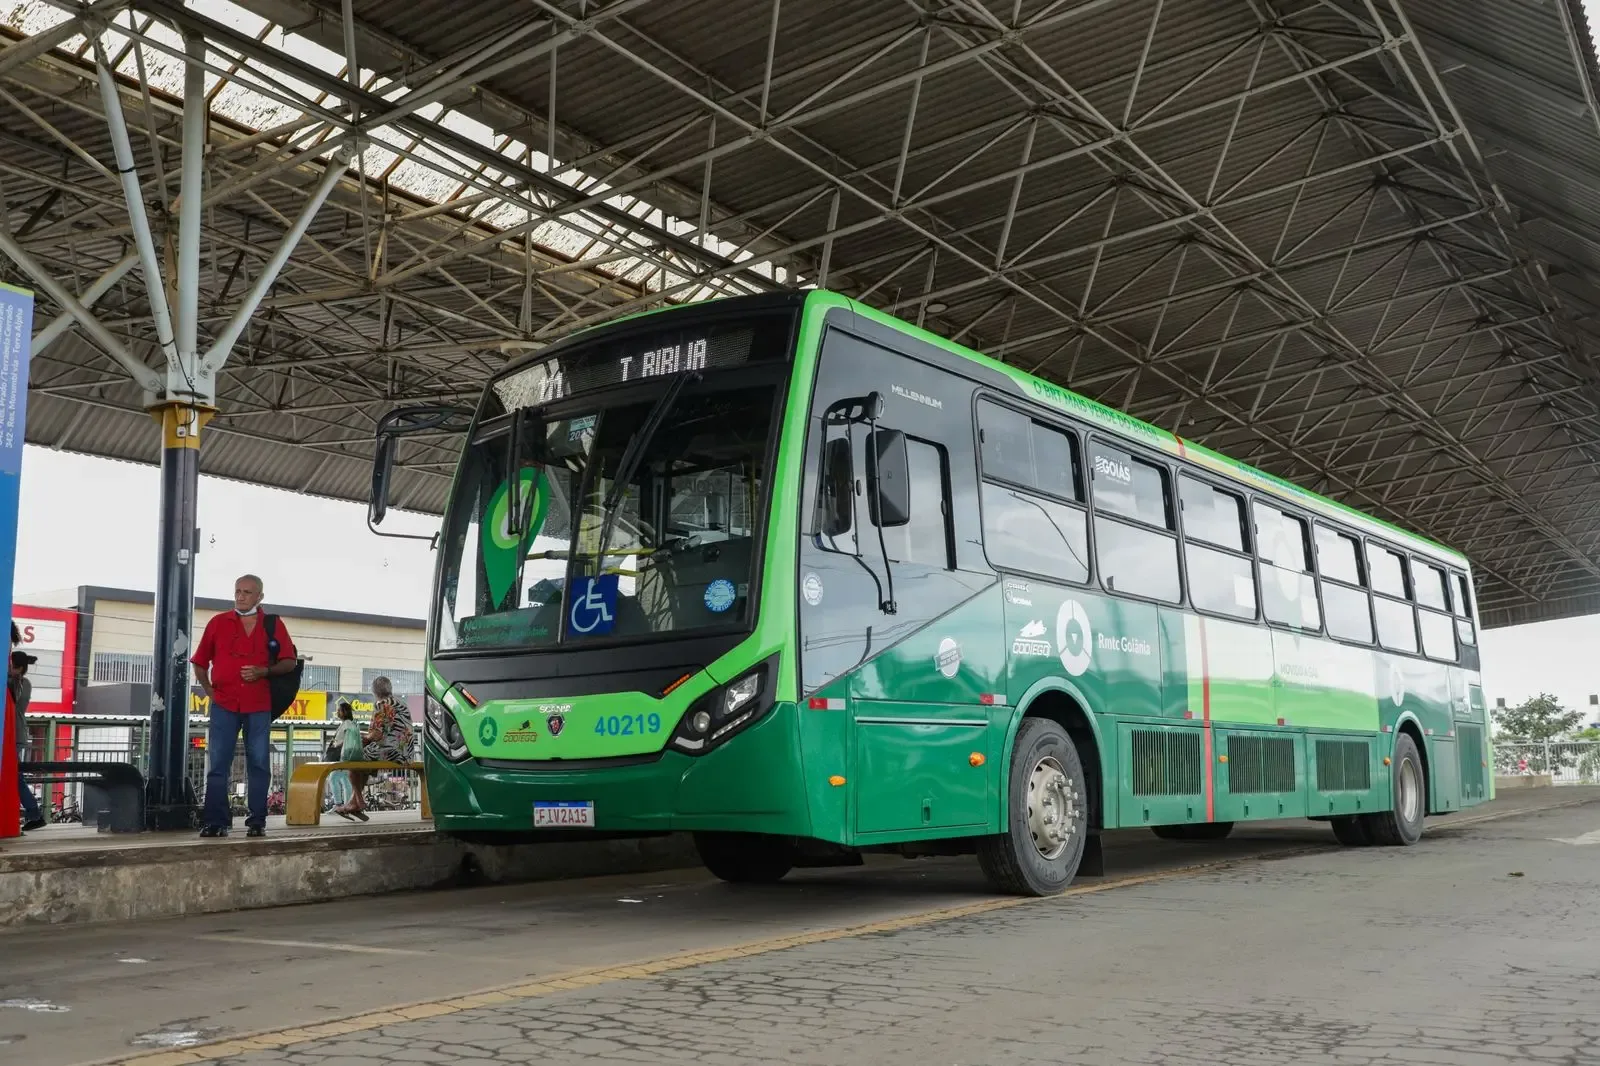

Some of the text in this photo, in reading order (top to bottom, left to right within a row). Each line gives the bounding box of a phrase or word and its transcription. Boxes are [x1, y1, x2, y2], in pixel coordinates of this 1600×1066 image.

[3, 304, 14, 337] Cerrado
[14, 308, 24, 332] Alpha
[12, 332, 21, 353] Terra
[620, 356, 632, 382] T
[5, 432, 13, 448] 342
[595, 713, 661, 737] 40219
